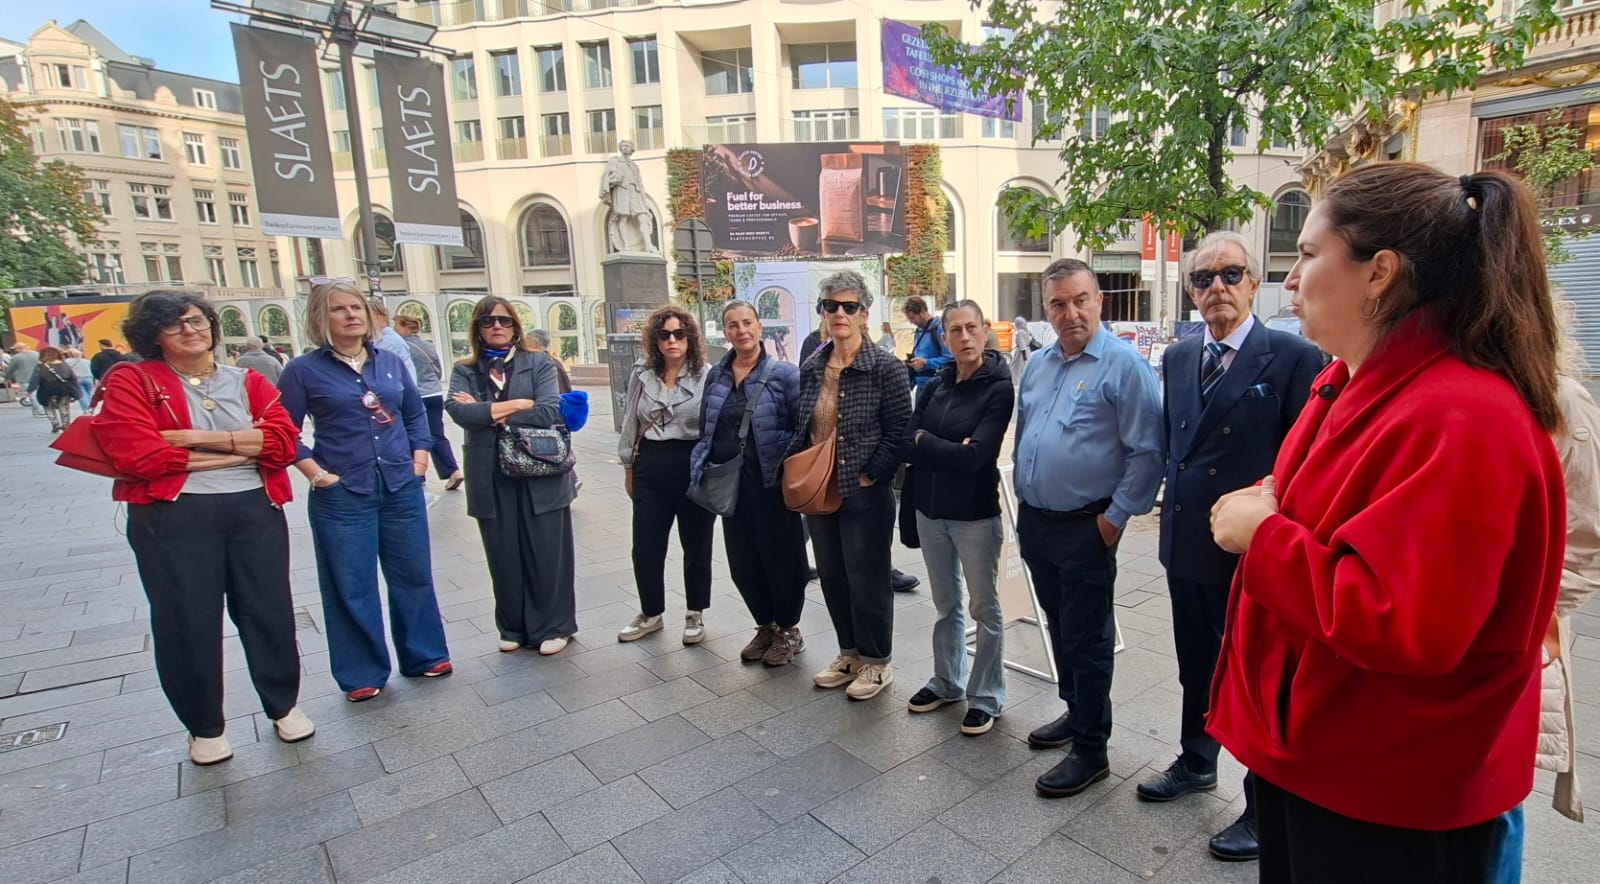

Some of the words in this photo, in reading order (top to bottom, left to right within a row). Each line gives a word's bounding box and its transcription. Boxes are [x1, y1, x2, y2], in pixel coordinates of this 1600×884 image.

[259, 61, 315, 182] SLAETS
[397, 84, 441, 195] SLAETS
[726, 191, 748, 201] Fuel
[749, 191, 764, 201] for
[727, 201, 758, 211] better
[759, 199, 804, 210] business.
